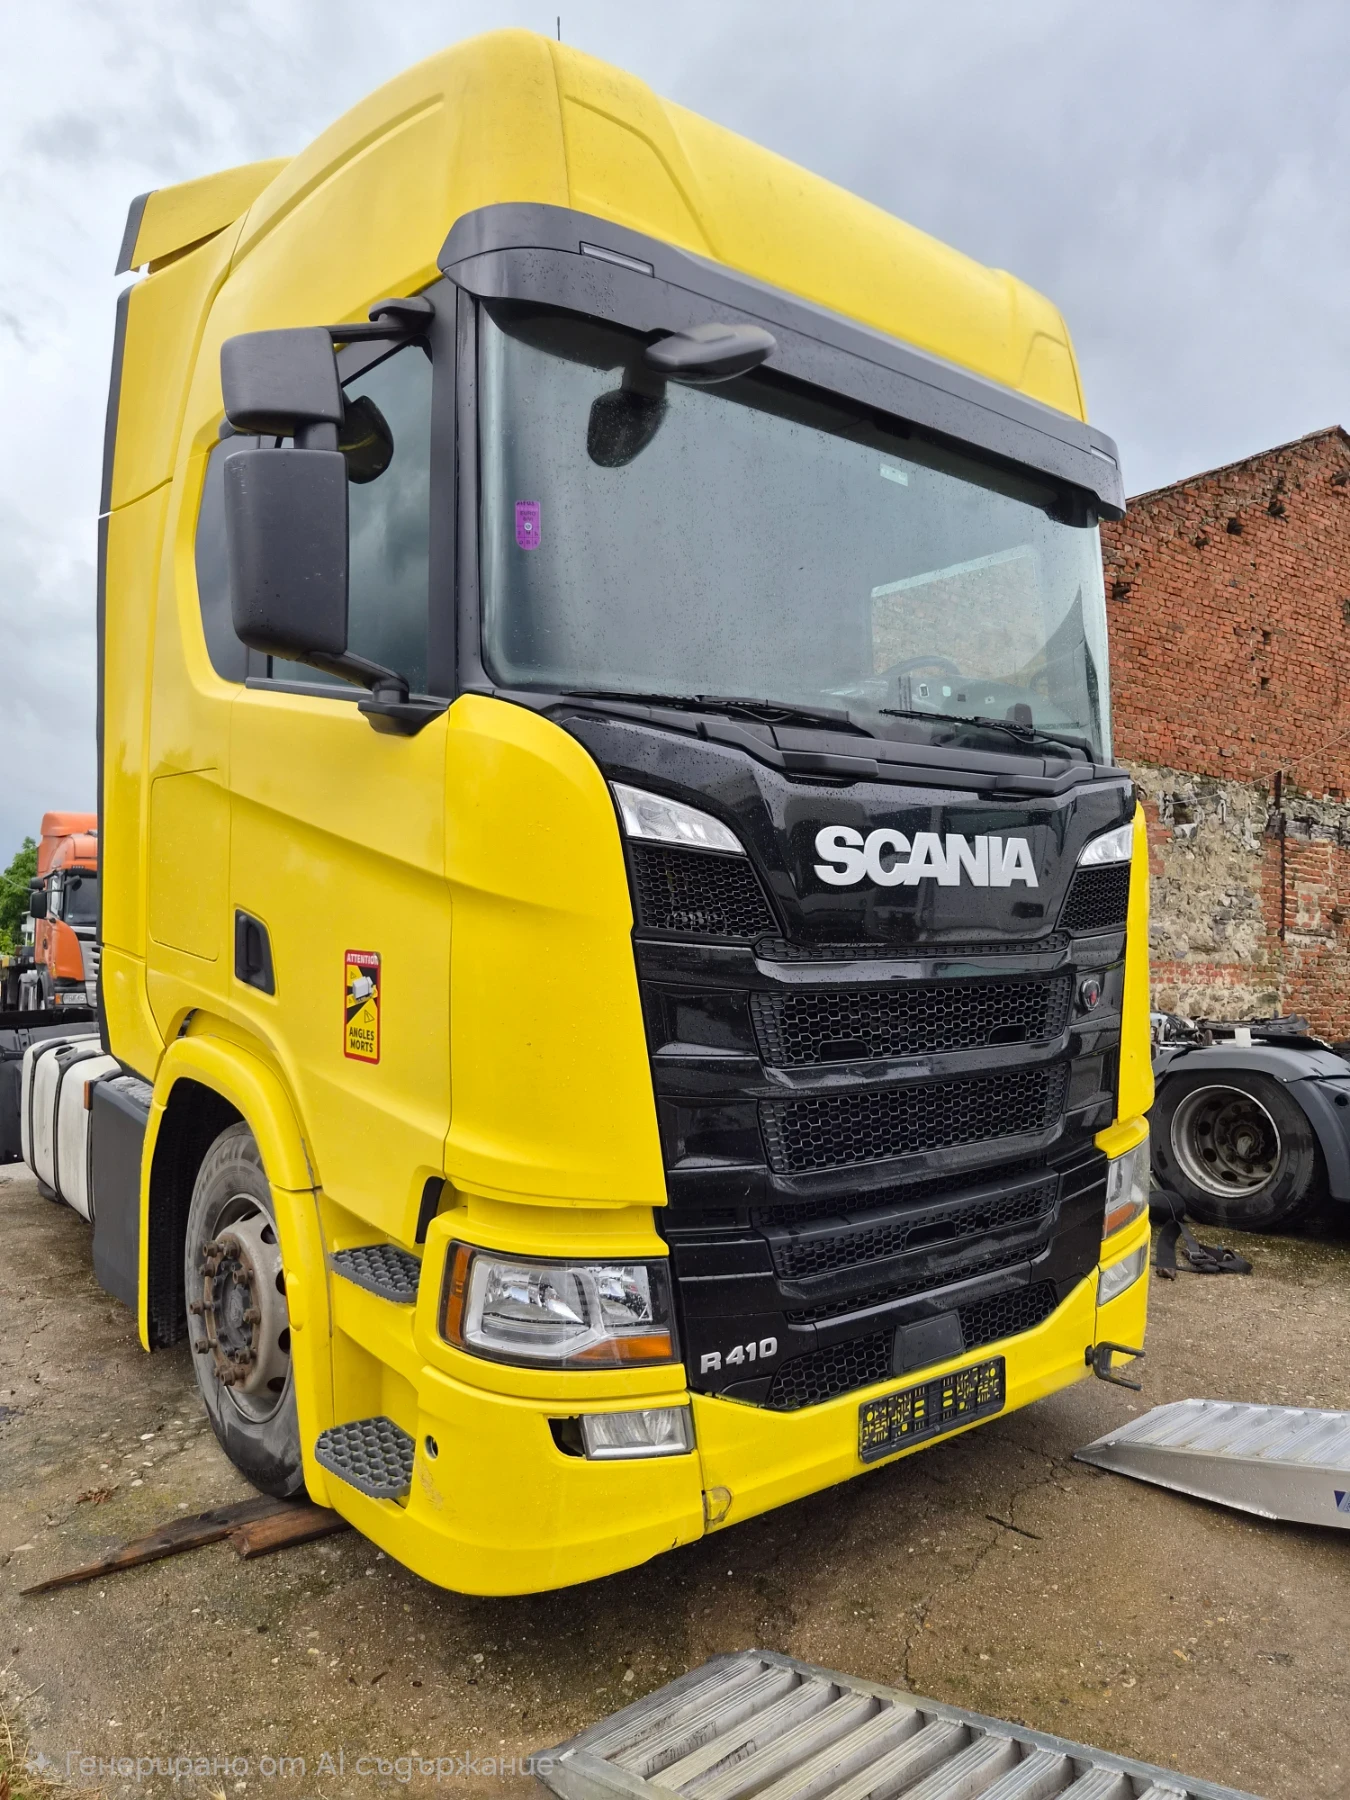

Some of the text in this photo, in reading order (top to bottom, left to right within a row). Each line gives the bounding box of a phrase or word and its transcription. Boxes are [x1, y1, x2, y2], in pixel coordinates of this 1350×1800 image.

[813, 825, 1039, 887] SCANIA
[347, 953, 379, 965] ATTENTION
[349, 1027, 374, 1041] ANGLES
[350, 1039, 373, 1053] MORTS
[701, 1337, 777, 1374] R 410
